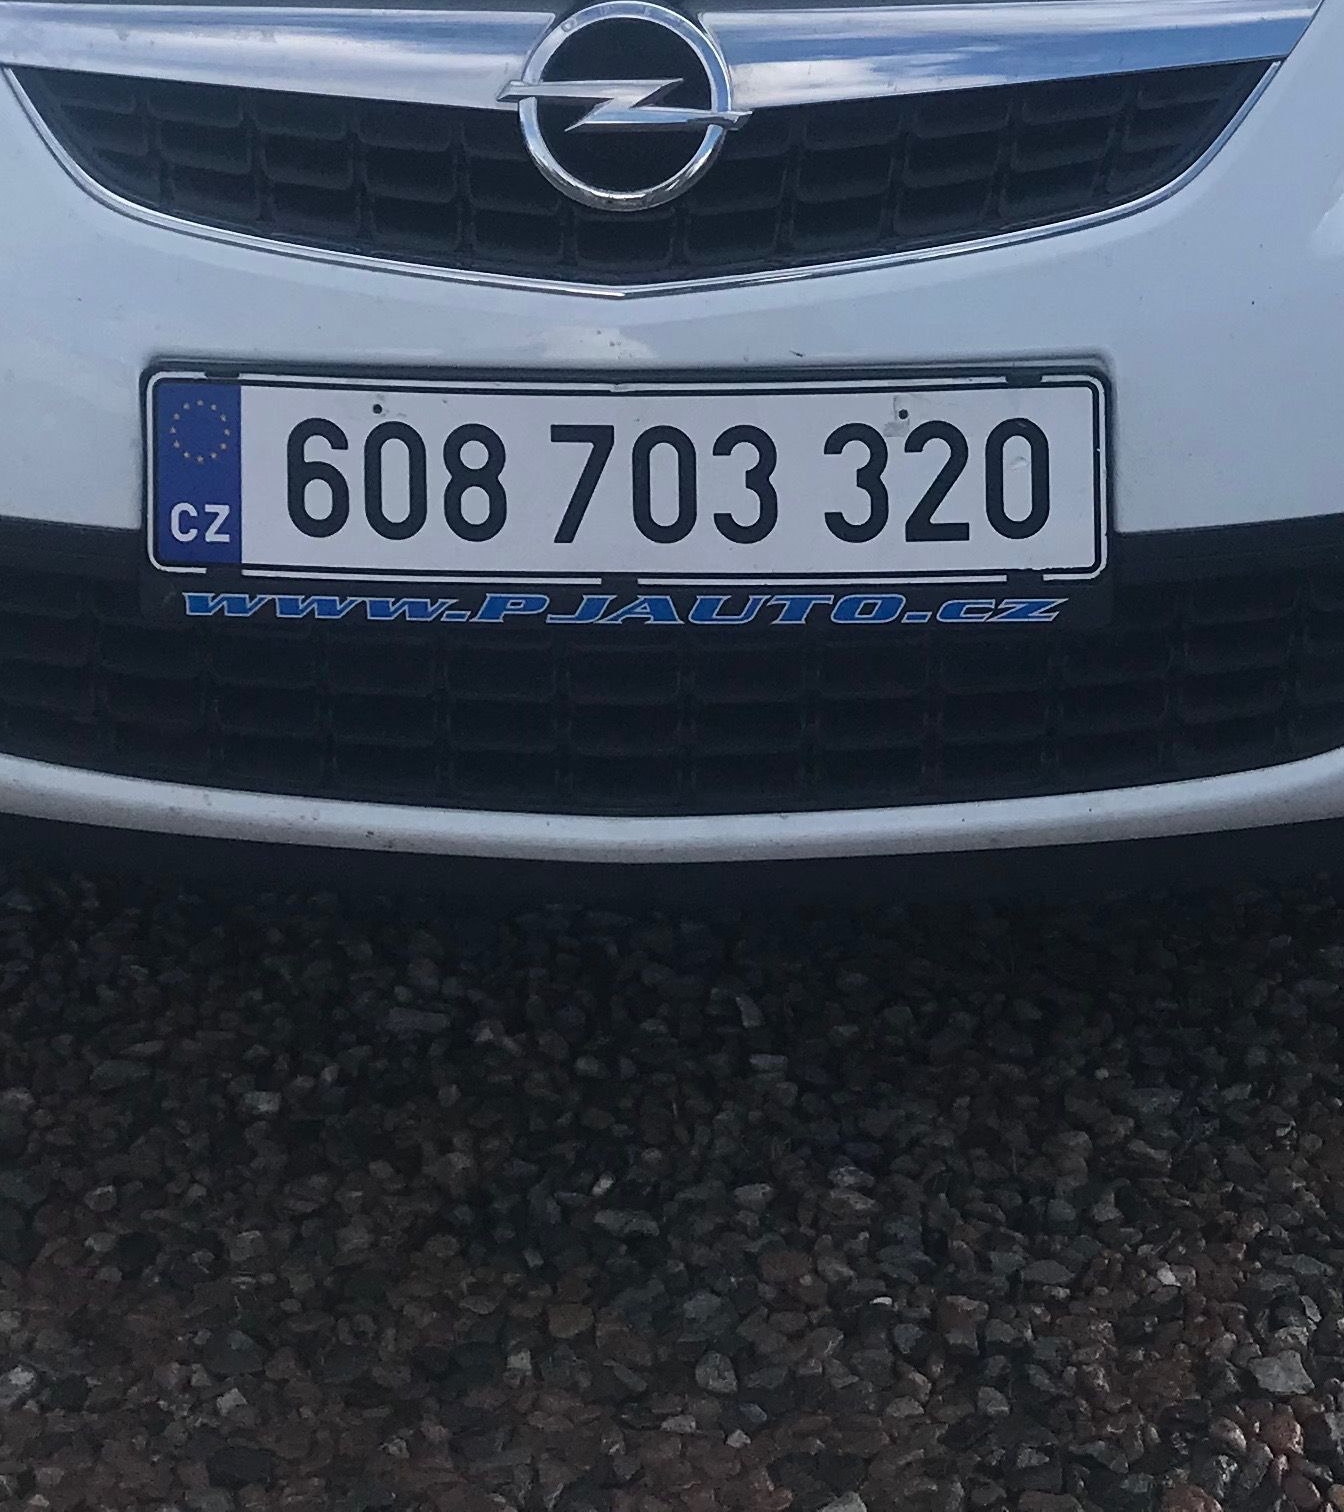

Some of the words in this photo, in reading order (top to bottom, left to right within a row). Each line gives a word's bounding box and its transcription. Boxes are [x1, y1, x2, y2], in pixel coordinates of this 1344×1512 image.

[169, 500, 231, 543] CZ
[286, 417, 509, 543] 608
[549, 423, 779, 545] 703
[822, 417, 1051, 544] 320
